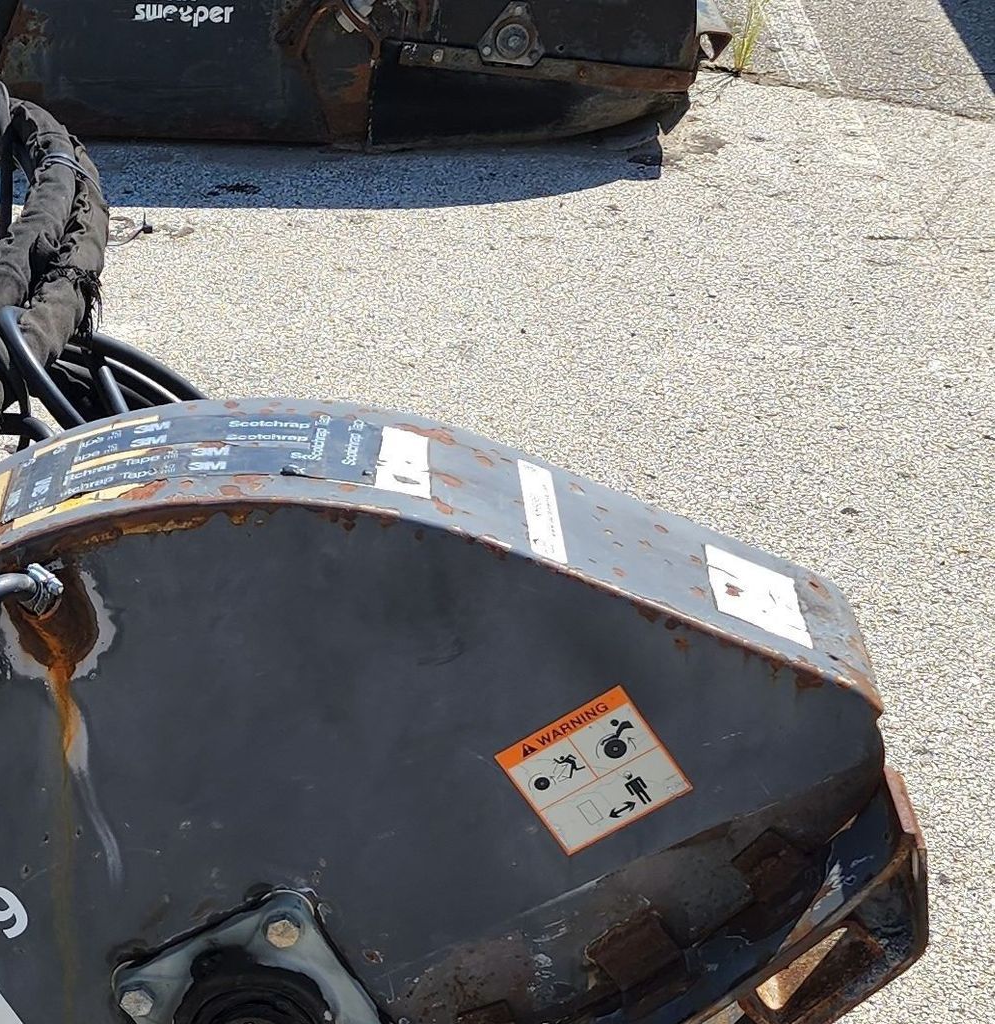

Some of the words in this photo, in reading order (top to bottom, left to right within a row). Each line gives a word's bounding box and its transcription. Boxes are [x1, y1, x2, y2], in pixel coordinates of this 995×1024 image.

[133, 4, 234, 27] sweeper
[133, 421, 172, 433] 3M
[228, 420, 312, 430] Scotchrap
[130, 434, 168, 448] 3M
[225, 433, 309, 442] Scotchrap
[123, 455, 161, 467] Tape
[191, 445, 230, 456] 3M
[188, 460, 227, 471] 3M
[536, 702, 609, 746] WARNING
